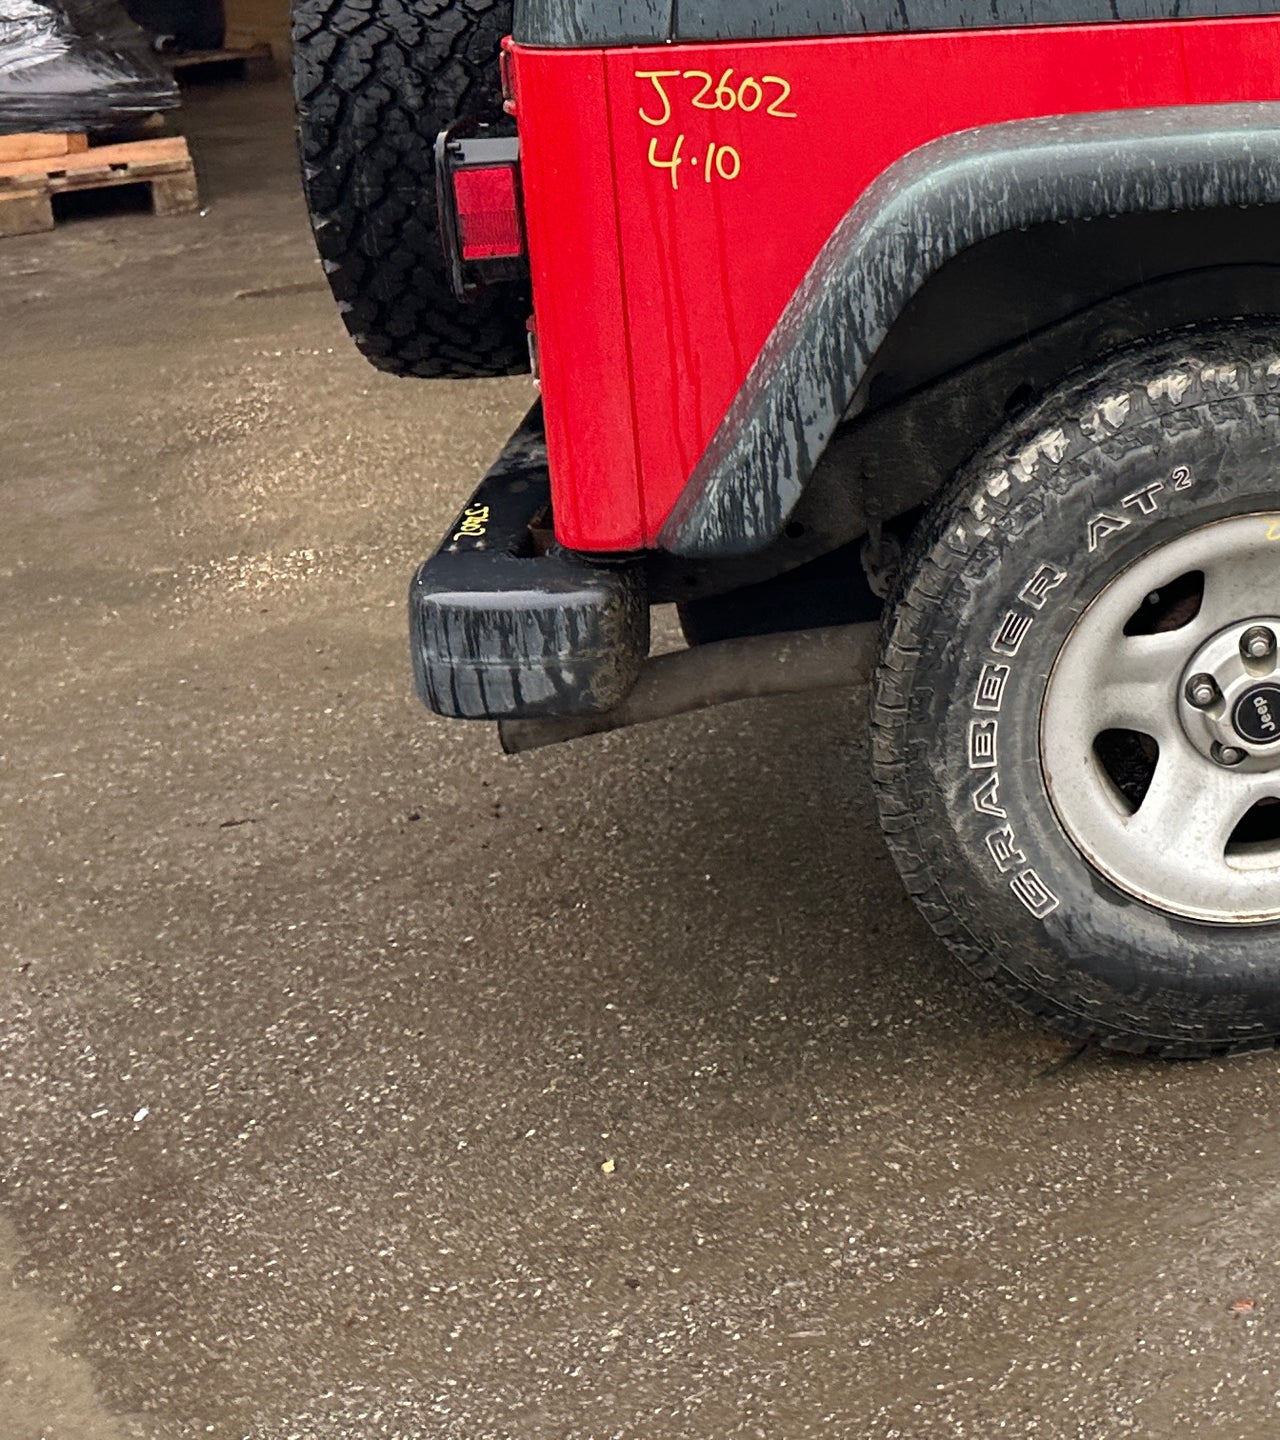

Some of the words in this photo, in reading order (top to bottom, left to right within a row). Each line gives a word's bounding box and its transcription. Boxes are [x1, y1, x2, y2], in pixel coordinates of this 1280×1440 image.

[635, 68, 797, 126] J2602
[969, 563, 1067, 920] GRABBER
[1253, 696, 1276, 732] Jeep
